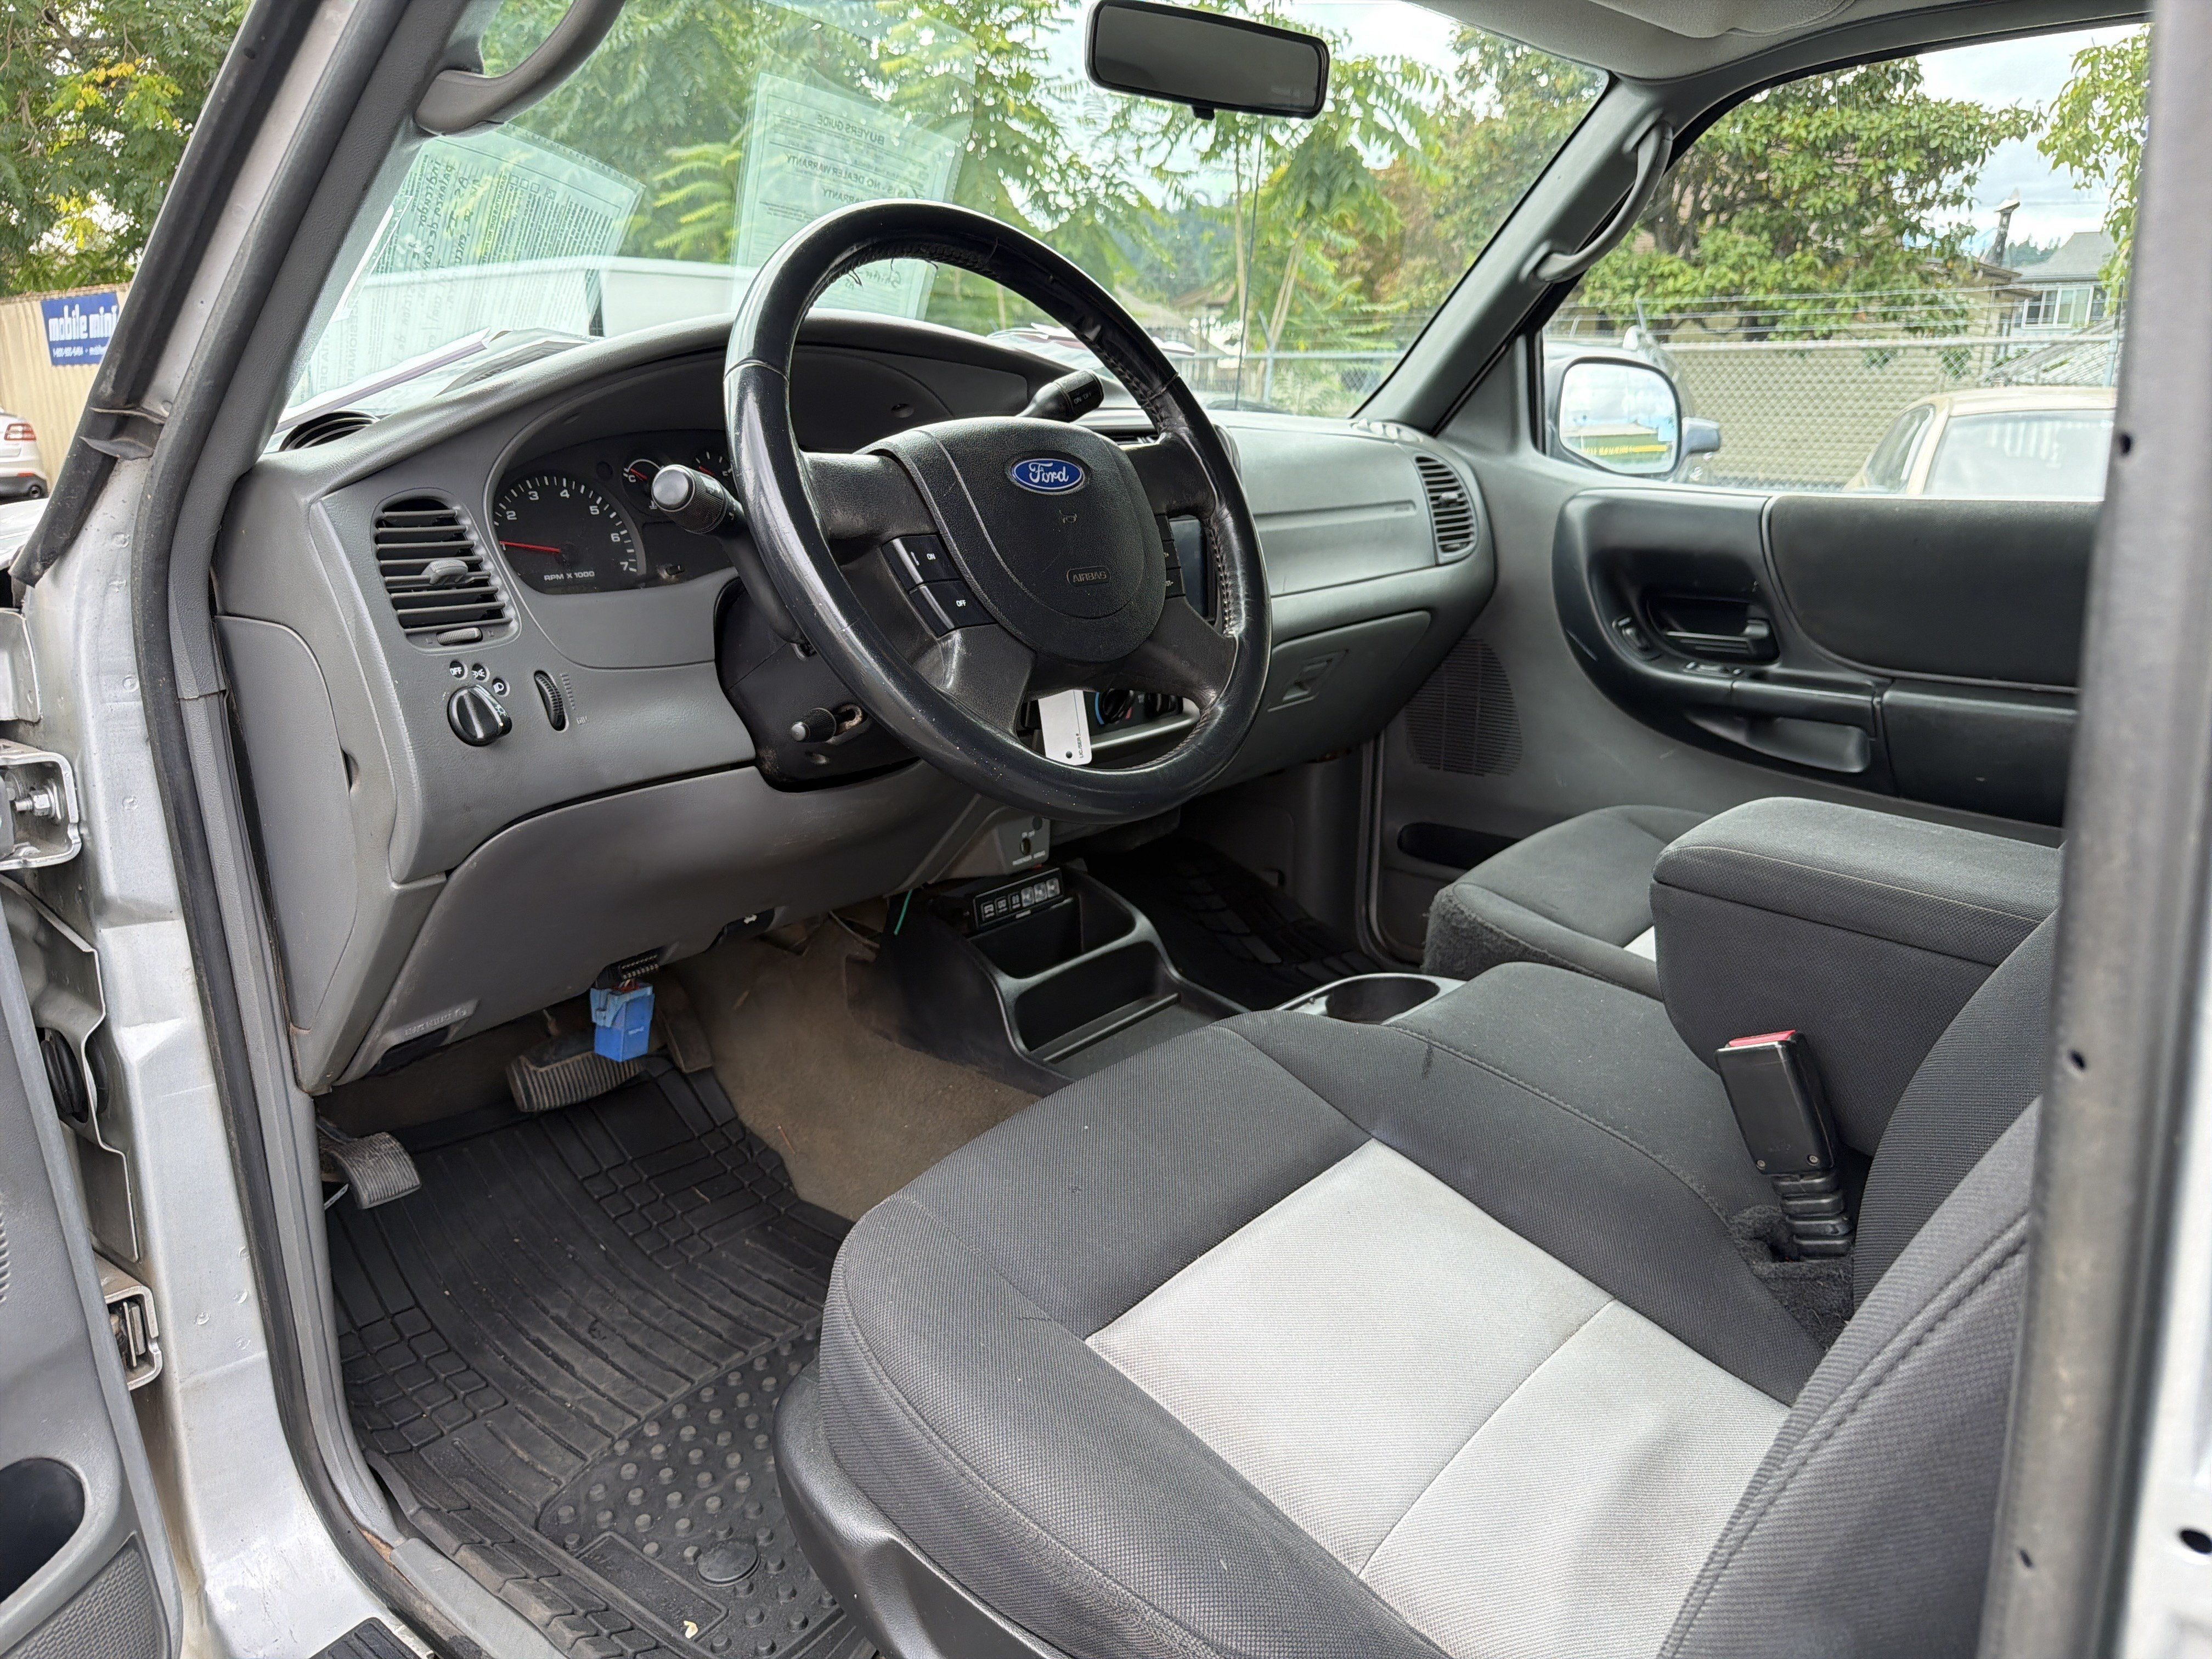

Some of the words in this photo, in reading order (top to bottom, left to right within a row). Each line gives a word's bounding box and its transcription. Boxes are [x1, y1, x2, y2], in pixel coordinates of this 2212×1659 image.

[48, 304, 88, 341] mobile
[1029, 462, 1069, 483] Ford
[528, 491, 539, 500] 3
[560, 489, 569, 498] 4
[506, 510, 517, 520] 2
[589, 505, 600, 515] 5
[611, 533, 620, 542] 6
[620, 561, 629, 571] 7
[544, 573, 564, 581] RPM
[574, 571, 595, 579] 1000
[1073, 571, 1107, 583] AIRBAG
[956, 599, 966, 607] OFF
[449, 667, 462, 676] OFF
